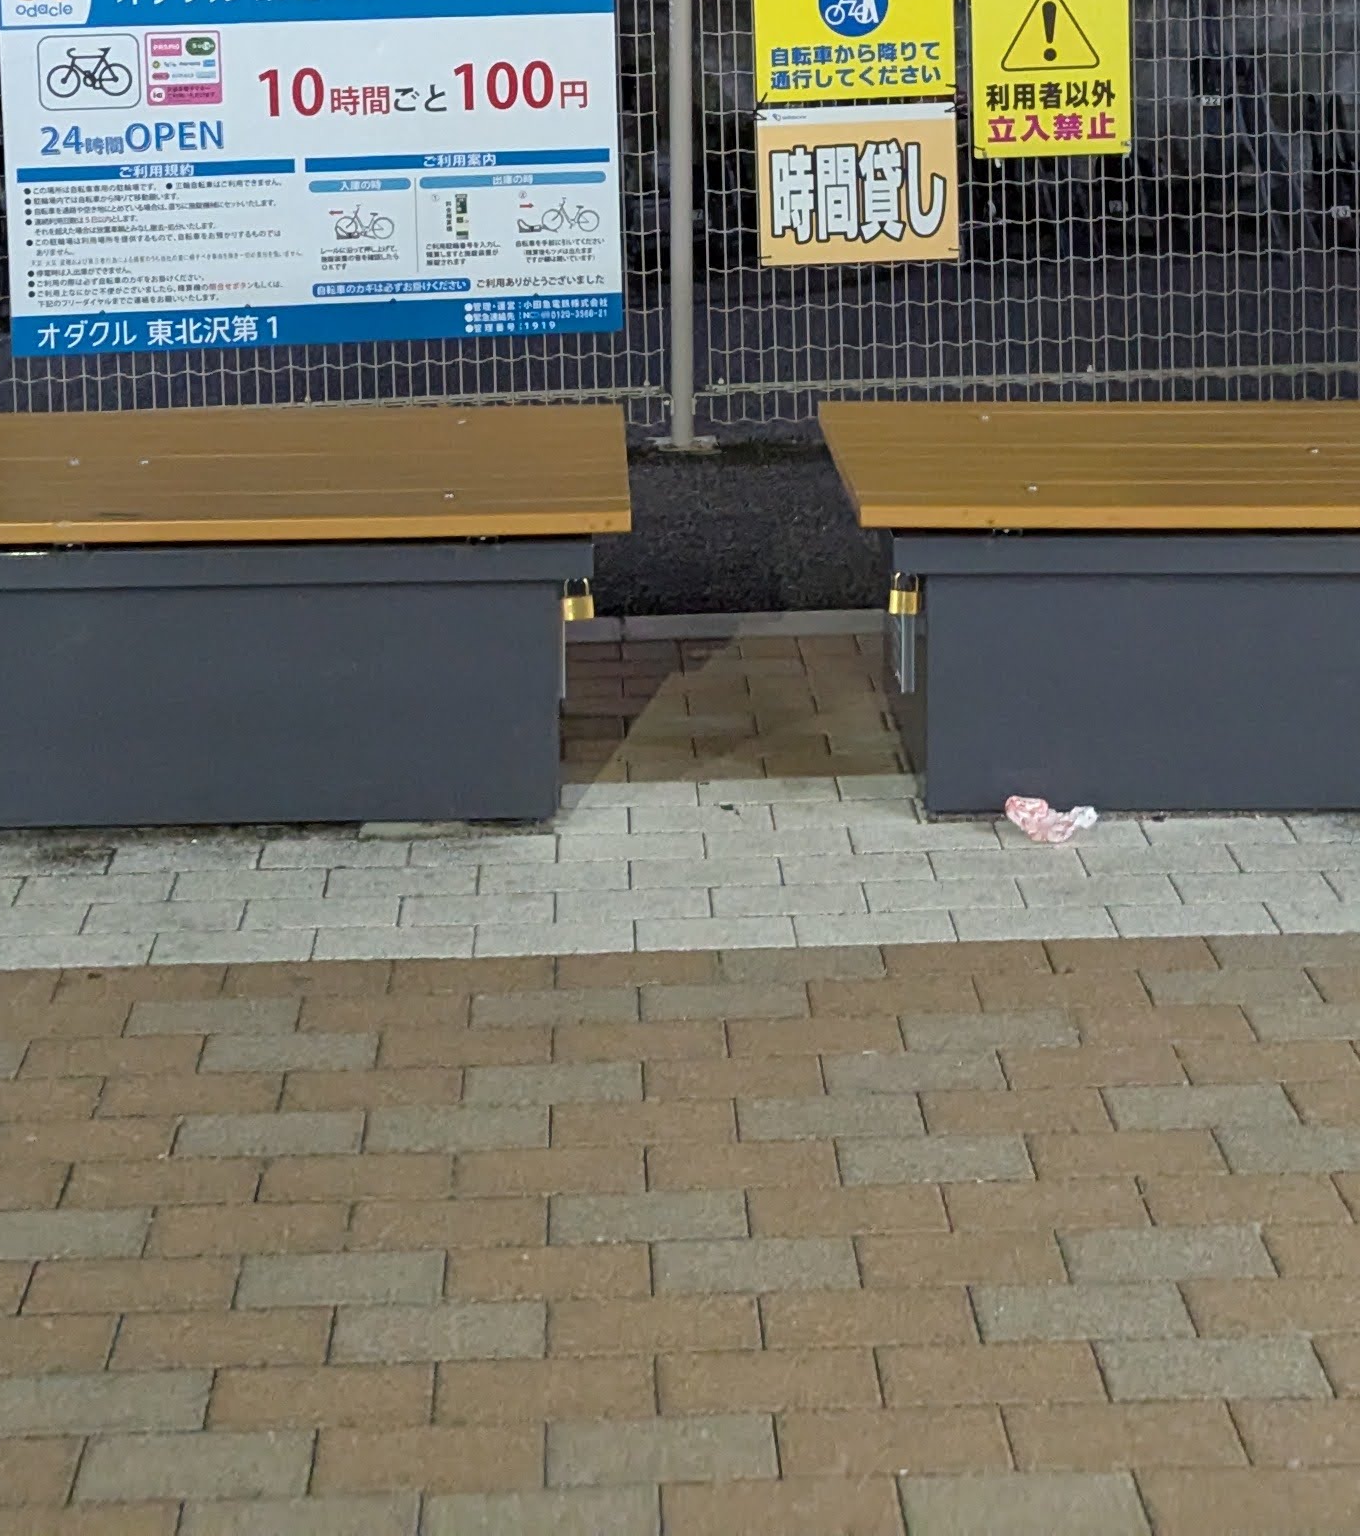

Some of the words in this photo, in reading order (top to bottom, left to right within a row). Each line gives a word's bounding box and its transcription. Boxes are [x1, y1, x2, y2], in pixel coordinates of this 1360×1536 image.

[16, 2, 73, 17] odacle
[770, 41, 941, 67] 自転車から降りて
[770, 64, 941, 91] 通行してください
[986, 82, 1116, 112] 利用者以外
[987, 113, 1117, 143] 立入禁止
[119, 163, 195, 179] ご利用規約
[423, 152, 497, 168] ご利用案内
[768, 138, 947, 245] 時間貸し
[316, 278, 468, 297] 自転車のカギは必ずお掛けください
[476, 274, 605, 289] ご利用ありがとうございました
[37, 318, 137, 348] オダクル
